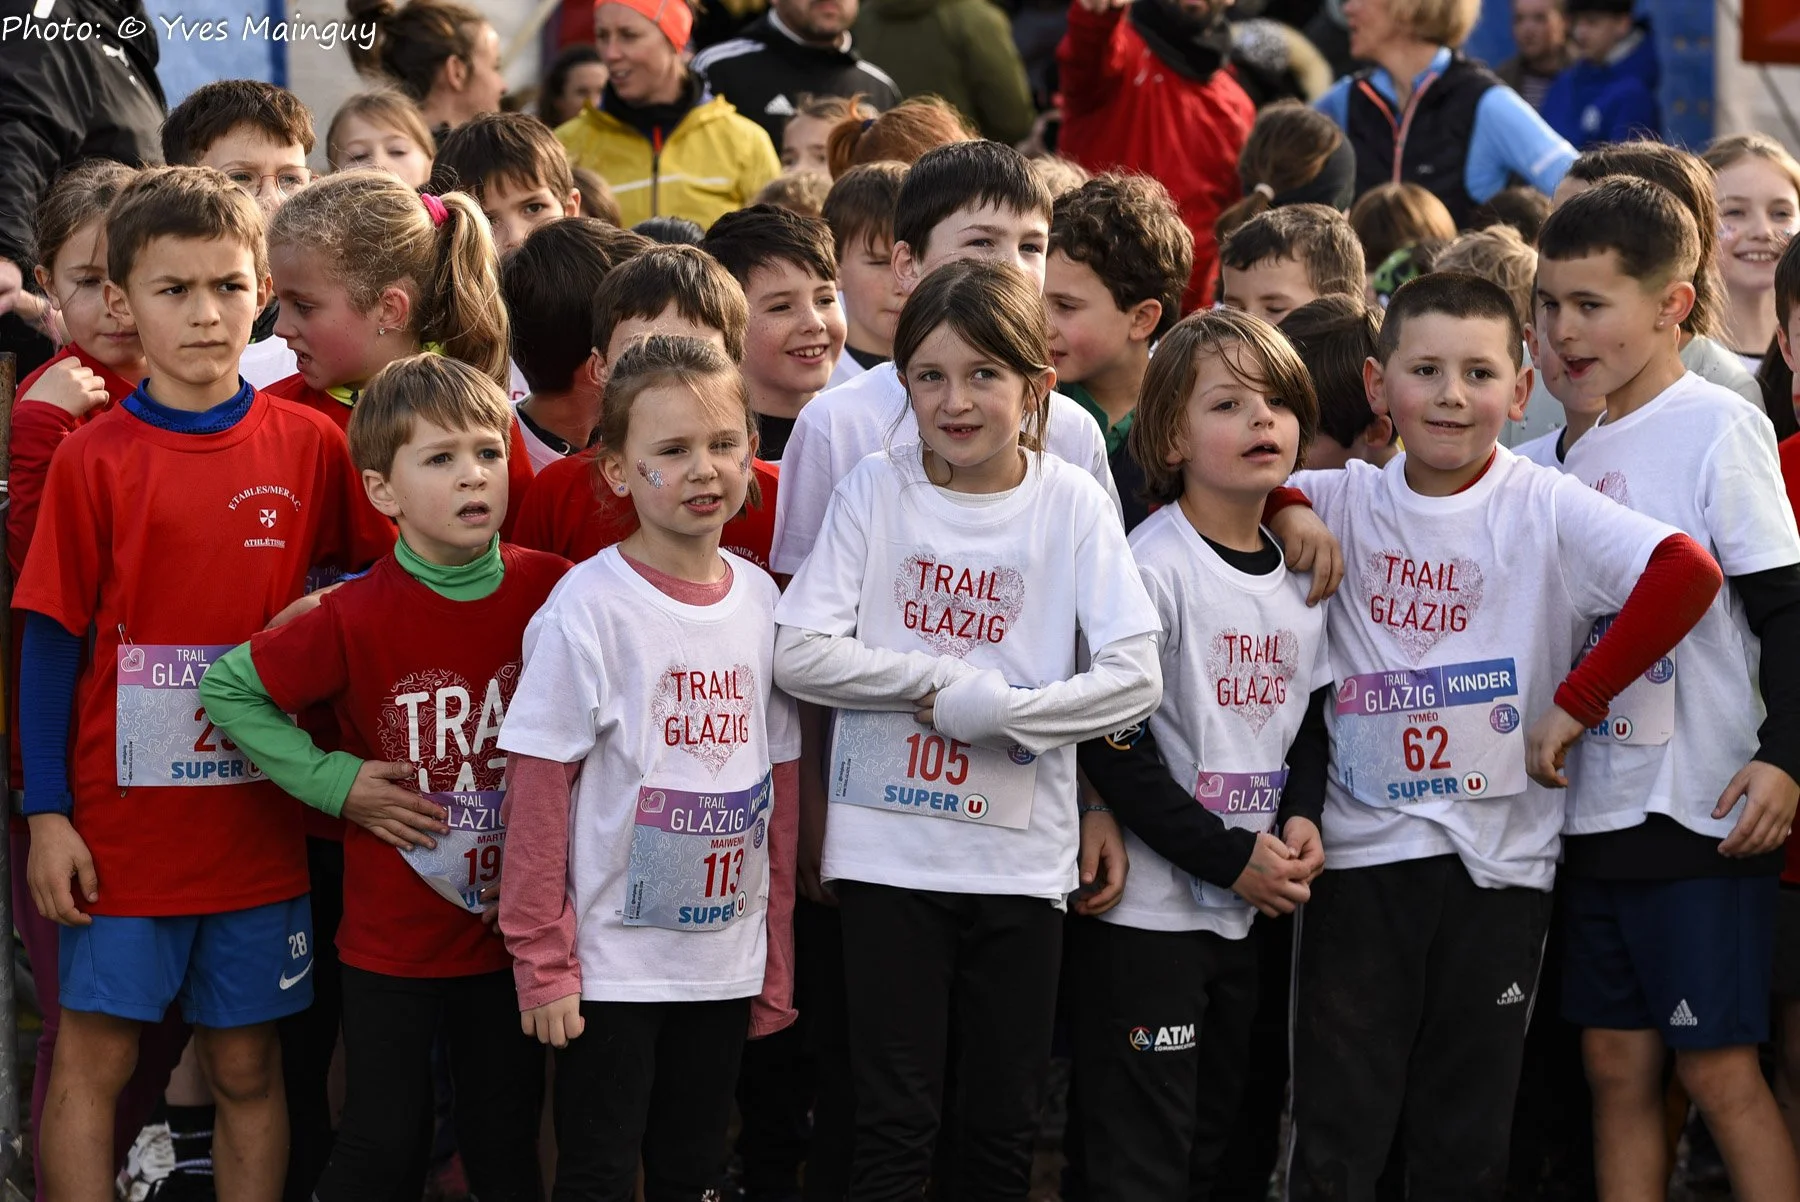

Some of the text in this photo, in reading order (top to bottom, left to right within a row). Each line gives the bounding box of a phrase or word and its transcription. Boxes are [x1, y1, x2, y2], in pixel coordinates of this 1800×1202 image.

[917, 560, 1001, 602] TRAIL
[1385, 555, 1460, 592] TRAIL
[904, 600, 1006, 643] GLAZIG
[1370, 594, 1468, 632] GLAZIG
[176, 649, 207, 662] TRAIL
[1223, 634, 1283, 664] TRAIL
[152, 663, 211, 687] GLAZ
[670, 670, 744, 702] TRAIL
[1383, 673, 1410, 688] TRAIL
[1447, 670, 1512, 694] KINDER
[1216, 675, 1287, 707] GLAZIG
[1365, 684, 1436, 713] GLAZIG
[193, 706, 237, 753] 2
[394, 678, 506, 763] TRA
[664, 714, 749, 747] GLAZIG
[1407, 711, 1439, 724] TYMÉO
[906, 732, 972, 786] 105
[1402, 725, 1452, 772] 62
[171, 759, 244, 780] SUPER
[1249, 775, 1271, 788] TRAIL
[453, 795, 485, 808] TRAIL
[698, 795, 727, 809] TRAIL
[883, 784, 960, 813] SUPER
[1386, 776, 1460, 800] SUPER
[447, 805, 506, 830] LAZI
[670, 808, 745, 834] GLAZIG
[703, 847, 745, 898] 113
[678, 902, 736, 925] SUPER
[288, 931, 308, 960] 28
[1154, 1023, 1195, 1046] ATM
